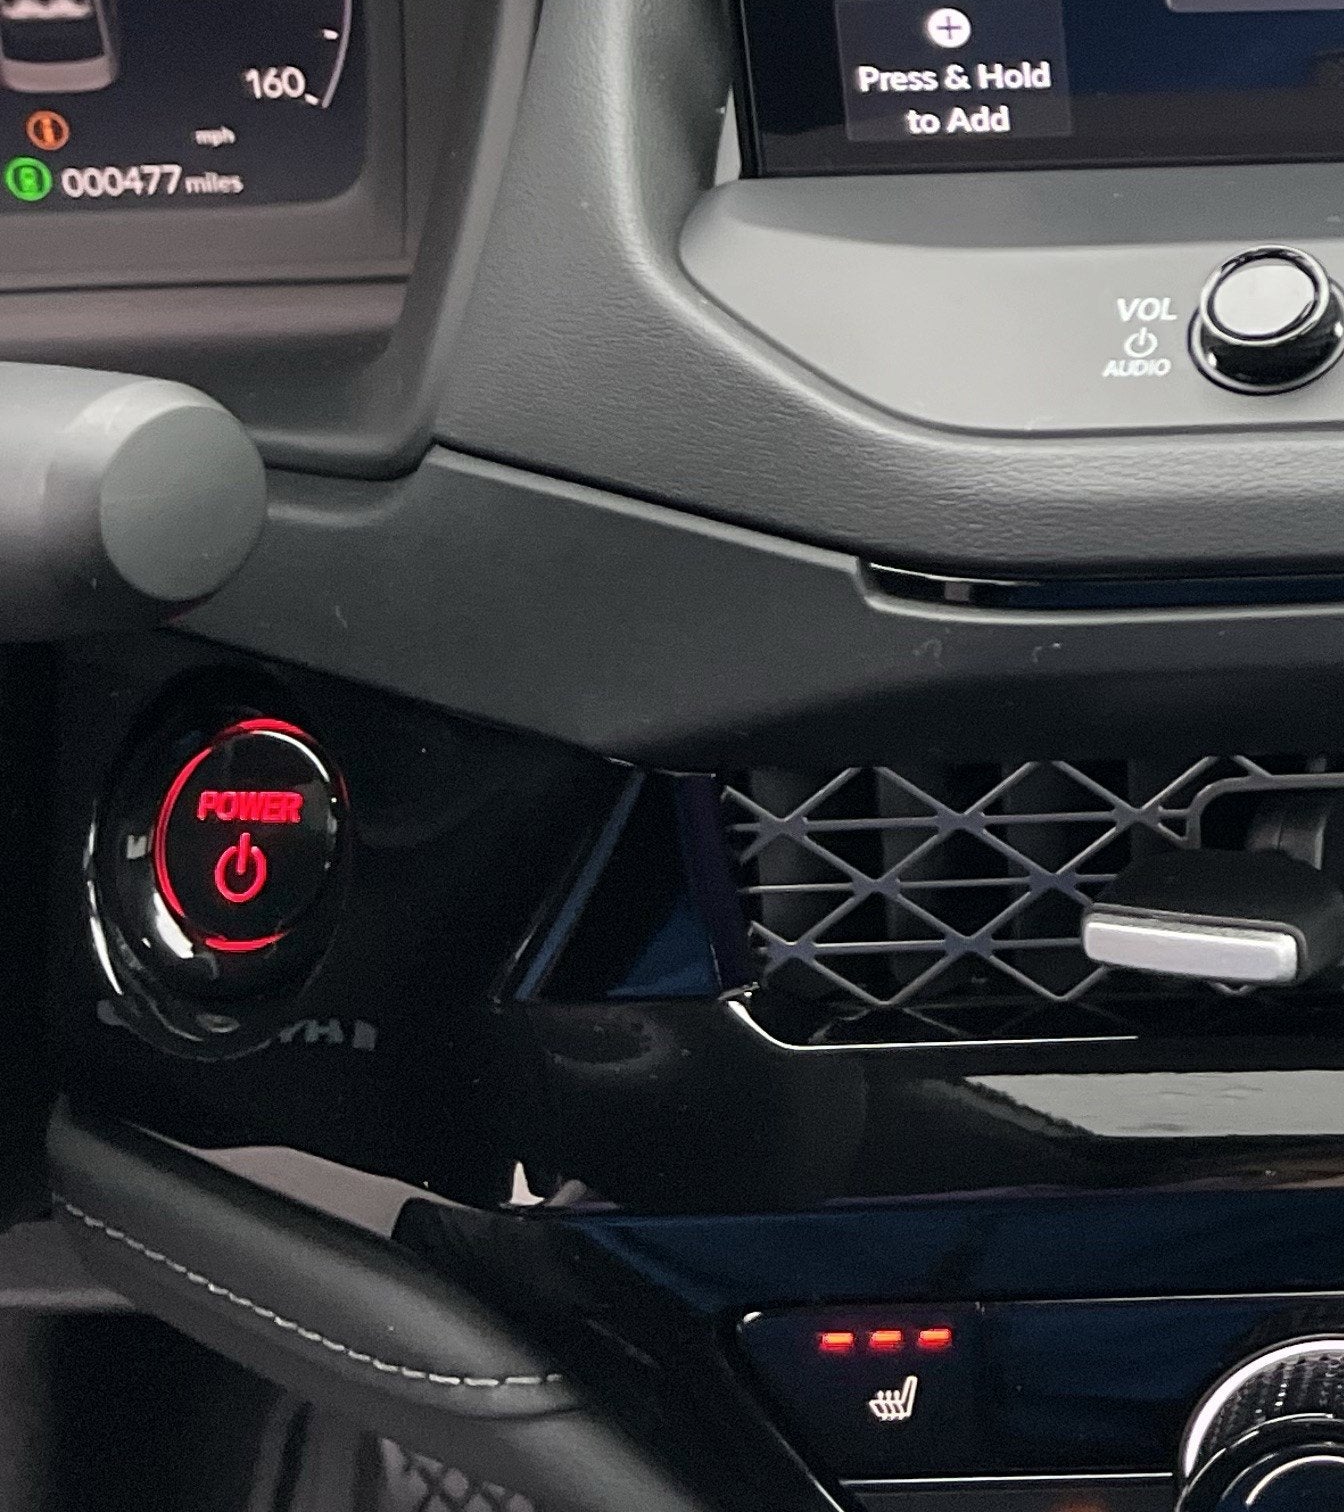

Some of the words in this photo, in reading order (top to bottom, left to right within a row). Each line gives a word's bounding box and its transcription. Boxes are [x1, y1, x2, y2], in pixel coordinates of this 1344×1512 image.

[245, 66, 305, 100] 160
[856, 65, 939, 93] Press
[943, 64, 972, 91] &
[976, 61, 1052, 90] Hold
[904, 109, 941, 135] to
[945, 104, 1011, 134] Add
[61, 163, 182, 198] 000477
[185, 171, 244, 194] miles
[1117, 297, 1178, 322] VOL
[1102, 358, 1172, 378] AUDIO
[196, 790, 304, 824] POWER
